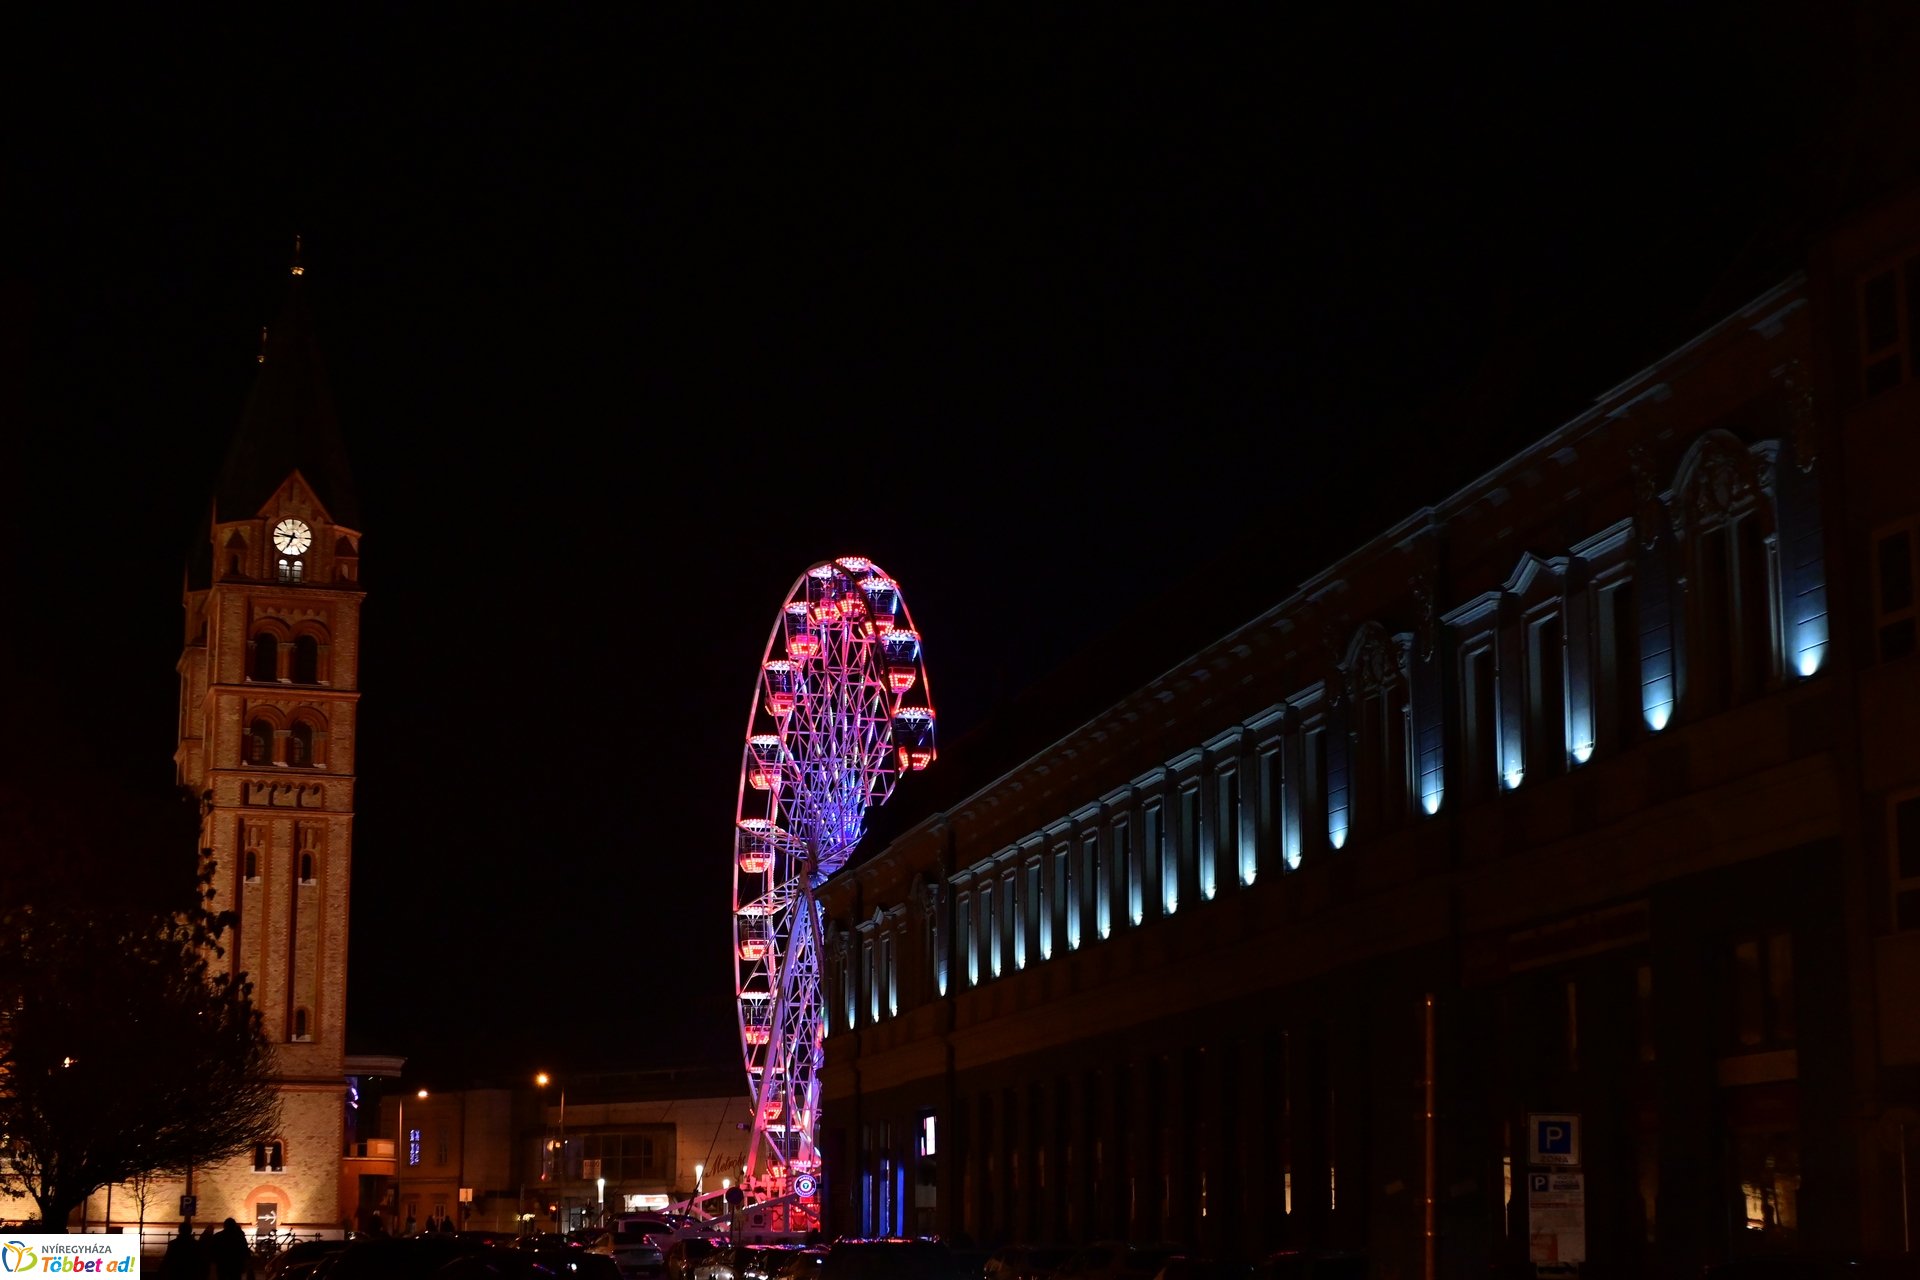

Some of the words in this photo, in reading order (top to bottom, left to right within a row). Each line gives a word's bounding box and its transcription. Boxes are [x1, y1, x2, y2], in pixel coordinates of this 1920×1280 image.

[1546, 1125, 1563, 1150] P
[1534, 1176, 1547, 1191] P
[183, 1196, 193, 1209] P
